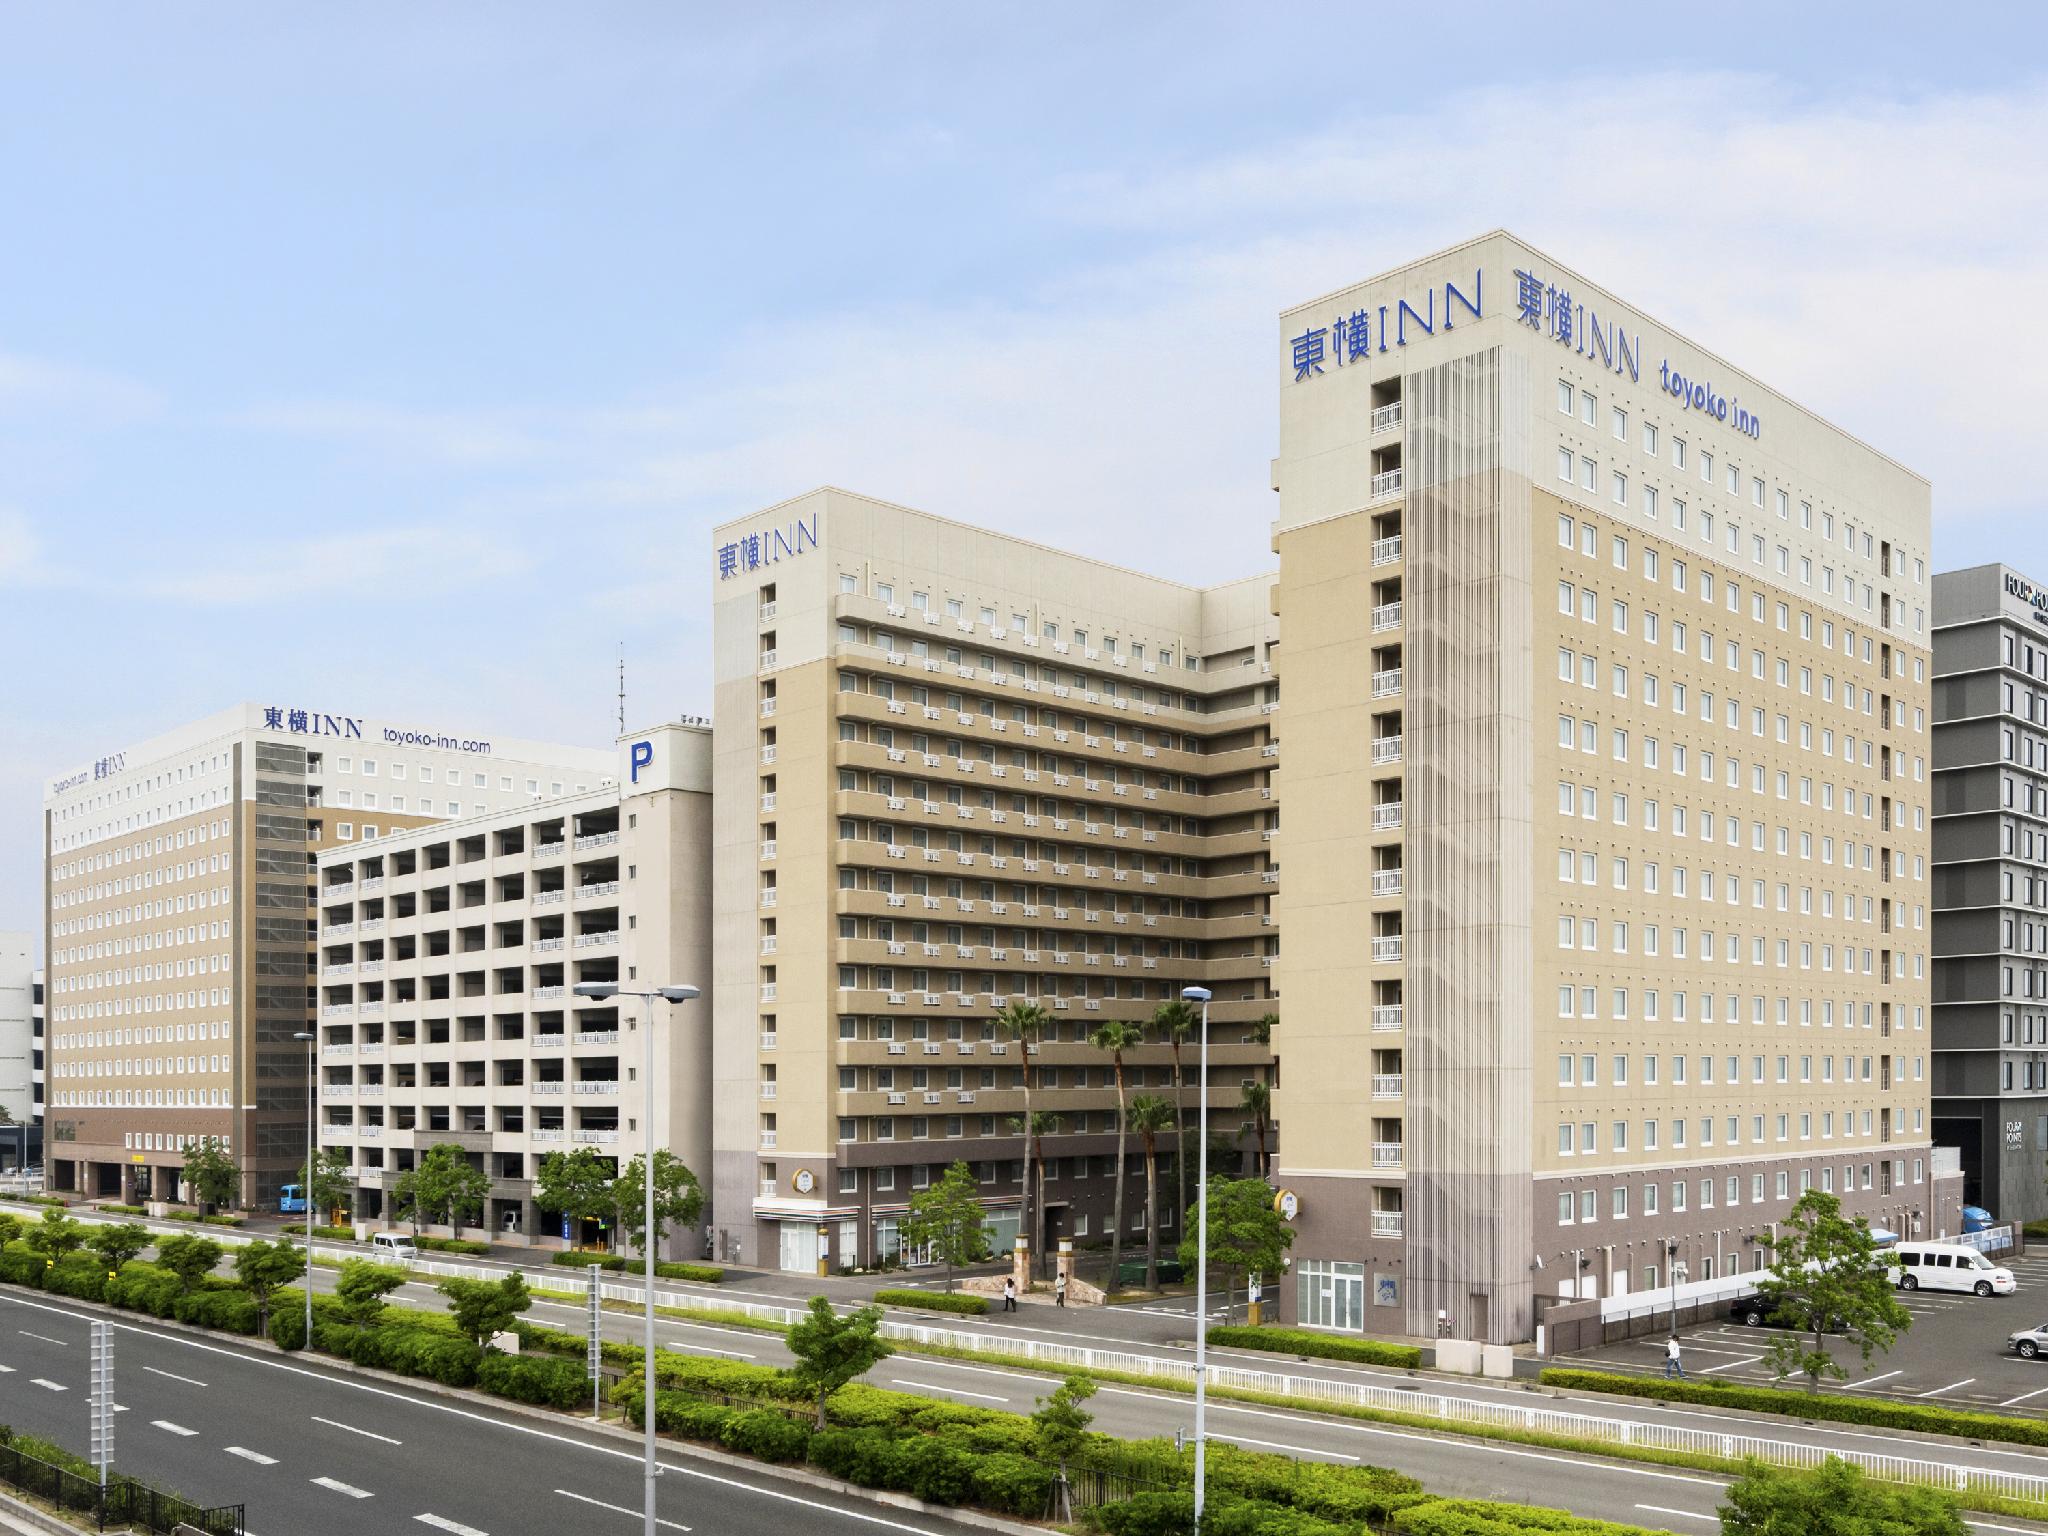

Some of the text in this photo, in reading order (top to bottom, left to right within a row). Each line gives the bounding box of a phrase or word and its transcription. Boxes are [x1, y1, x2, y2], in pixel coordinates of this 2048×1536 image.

[1290, 268, 1482, 382] 東横INN
[1513, 267, 1639, 382] 東横INN
[1659, 359, 1760, 440] toyoko inn
[717, 512, 818, 580] 東横INN
[263, 706, 362, 739] 東横INN
[383, 727, 491, 753] toyoko-inn.com
[631, 740, 653, 783] P
